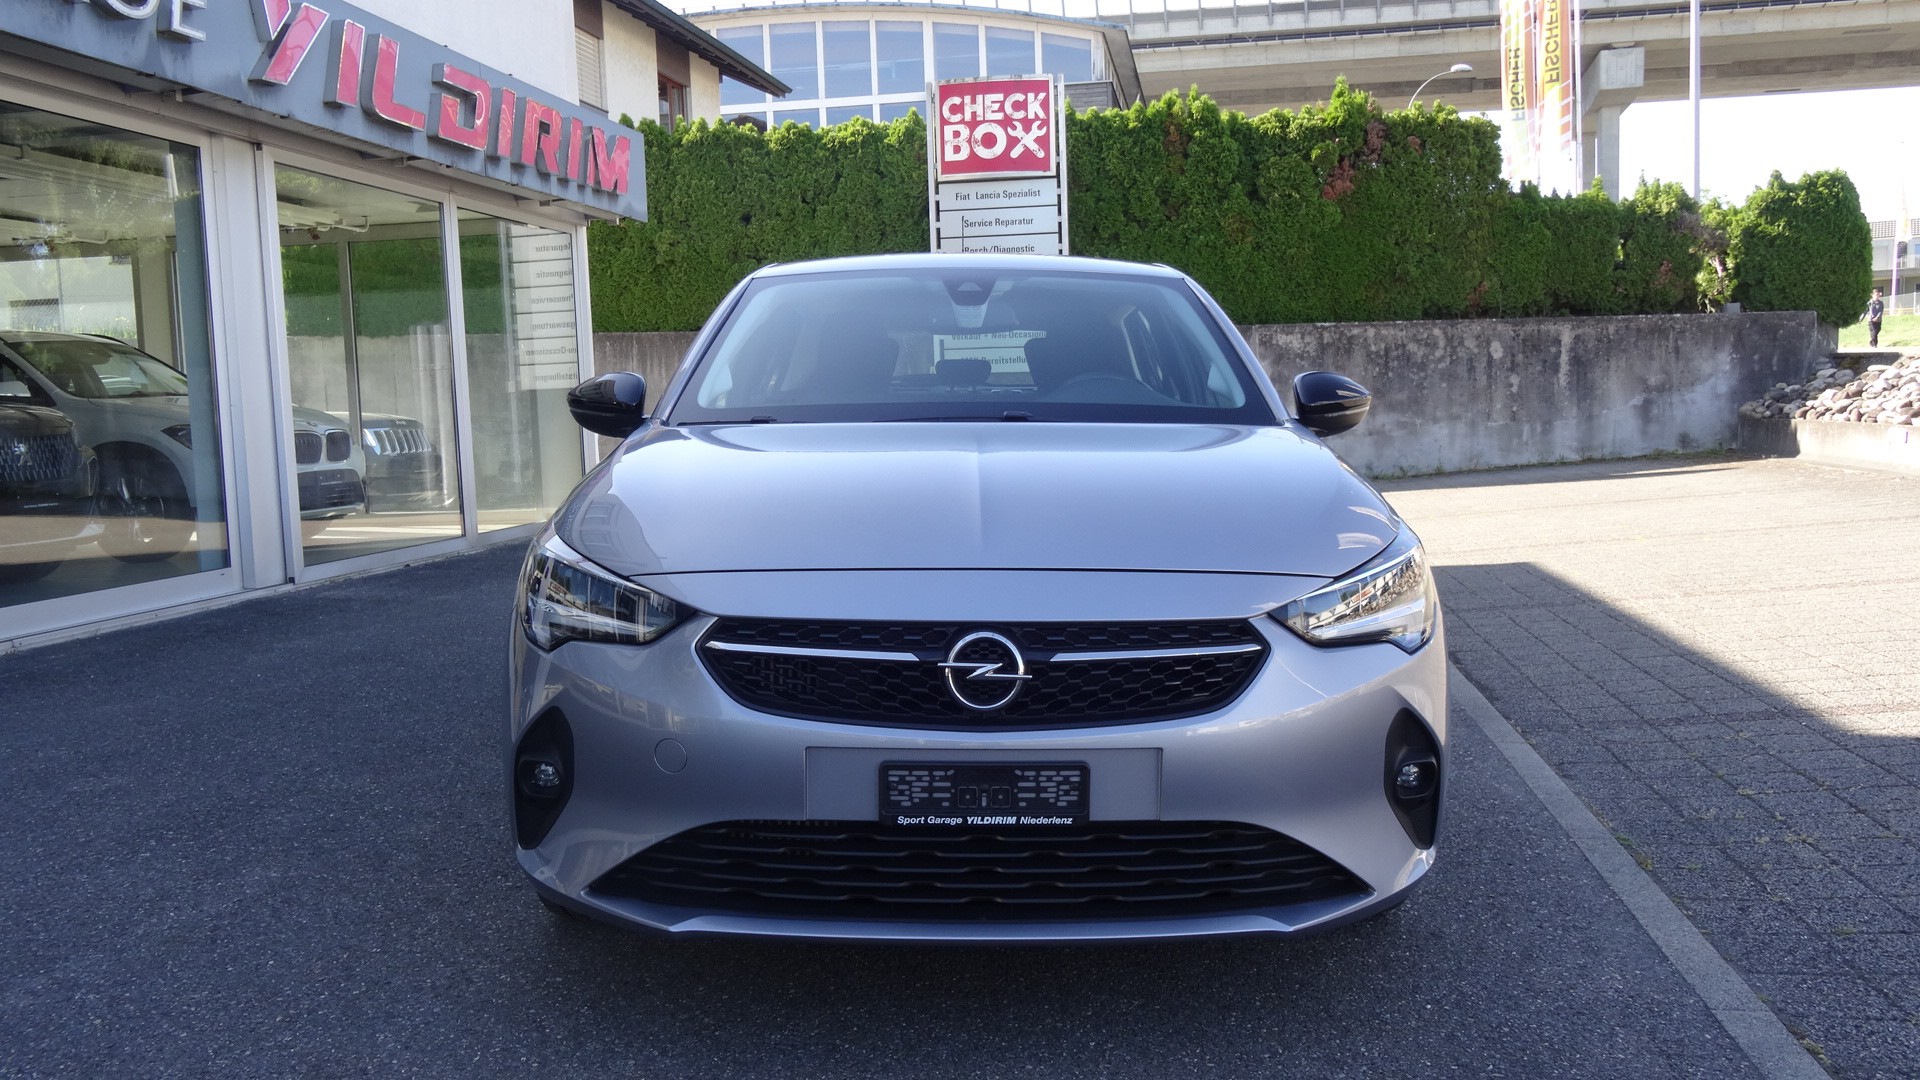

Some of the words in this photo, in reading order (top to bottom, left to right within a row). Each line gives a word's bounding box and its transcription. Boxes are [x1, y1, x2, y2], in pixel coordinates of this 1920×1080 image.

[251, 0, 631, 194] YILDIRIM
[942, 92, 1047, 123] CHECK
[955, 192, 970, 201] Fiat
[975, 190, 1001, 200] Lancia
[1002, 188, 1041, 200] Spezialist
[964, 218, 993, 228] Service
[995, 217, 1034, 228] Reparatur
[897, 815, 925, 825] Sport
[927, 815, 963, 825] Garage
[966, 816, 1017, 825] YILDIRIM
[1019, 815, 1073, 825] Niederlenz
